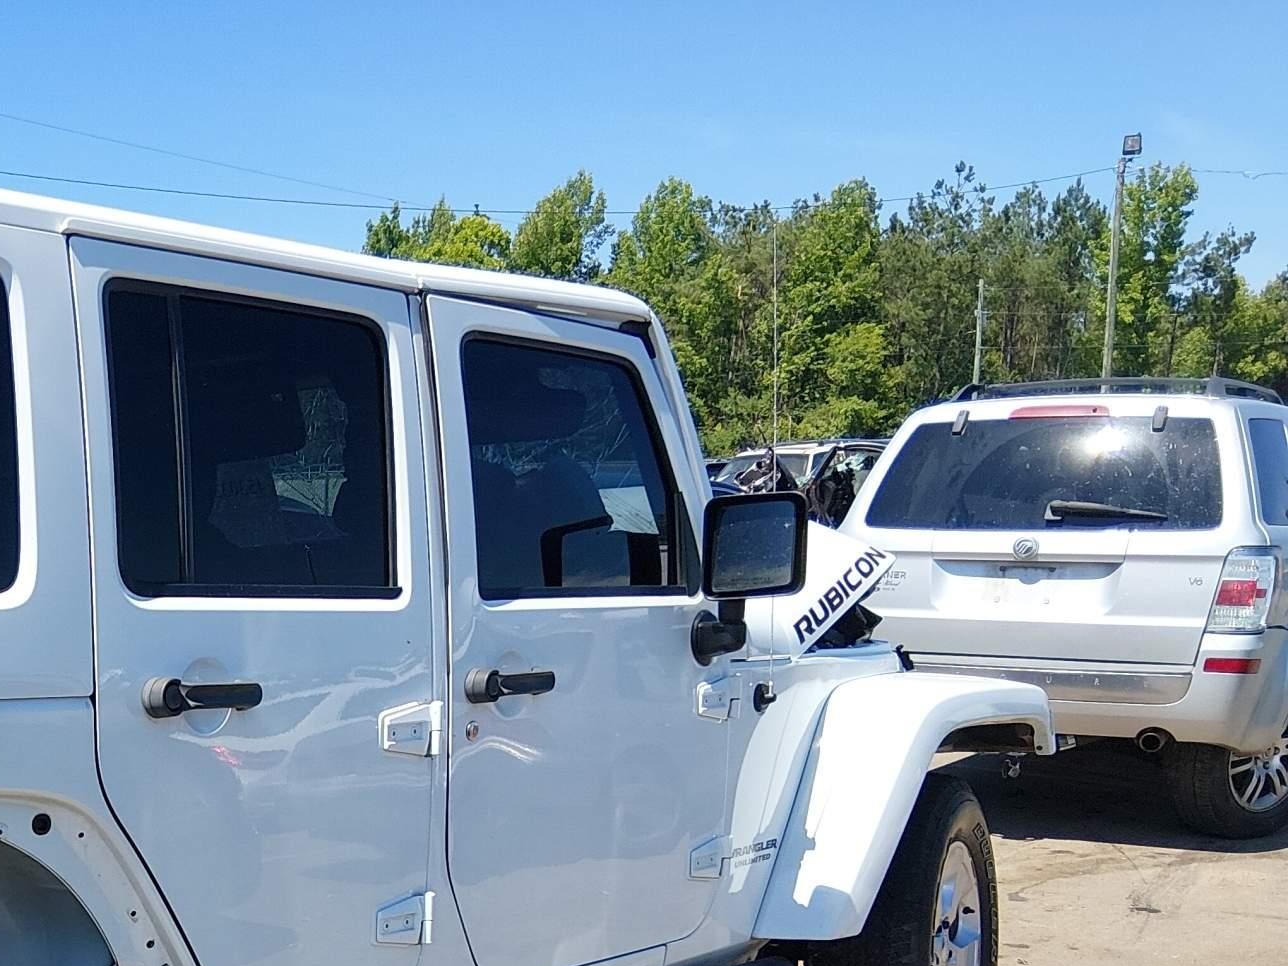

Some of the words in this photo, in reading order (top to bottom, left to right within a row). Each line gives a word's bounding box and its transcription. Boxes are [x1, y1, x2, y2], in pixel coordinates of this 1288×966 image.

[1188, 576, 1204, 586] V6
[793, 546, 887, 645] RUBICON
[734, 853, 772, 869] UNLIMITED
